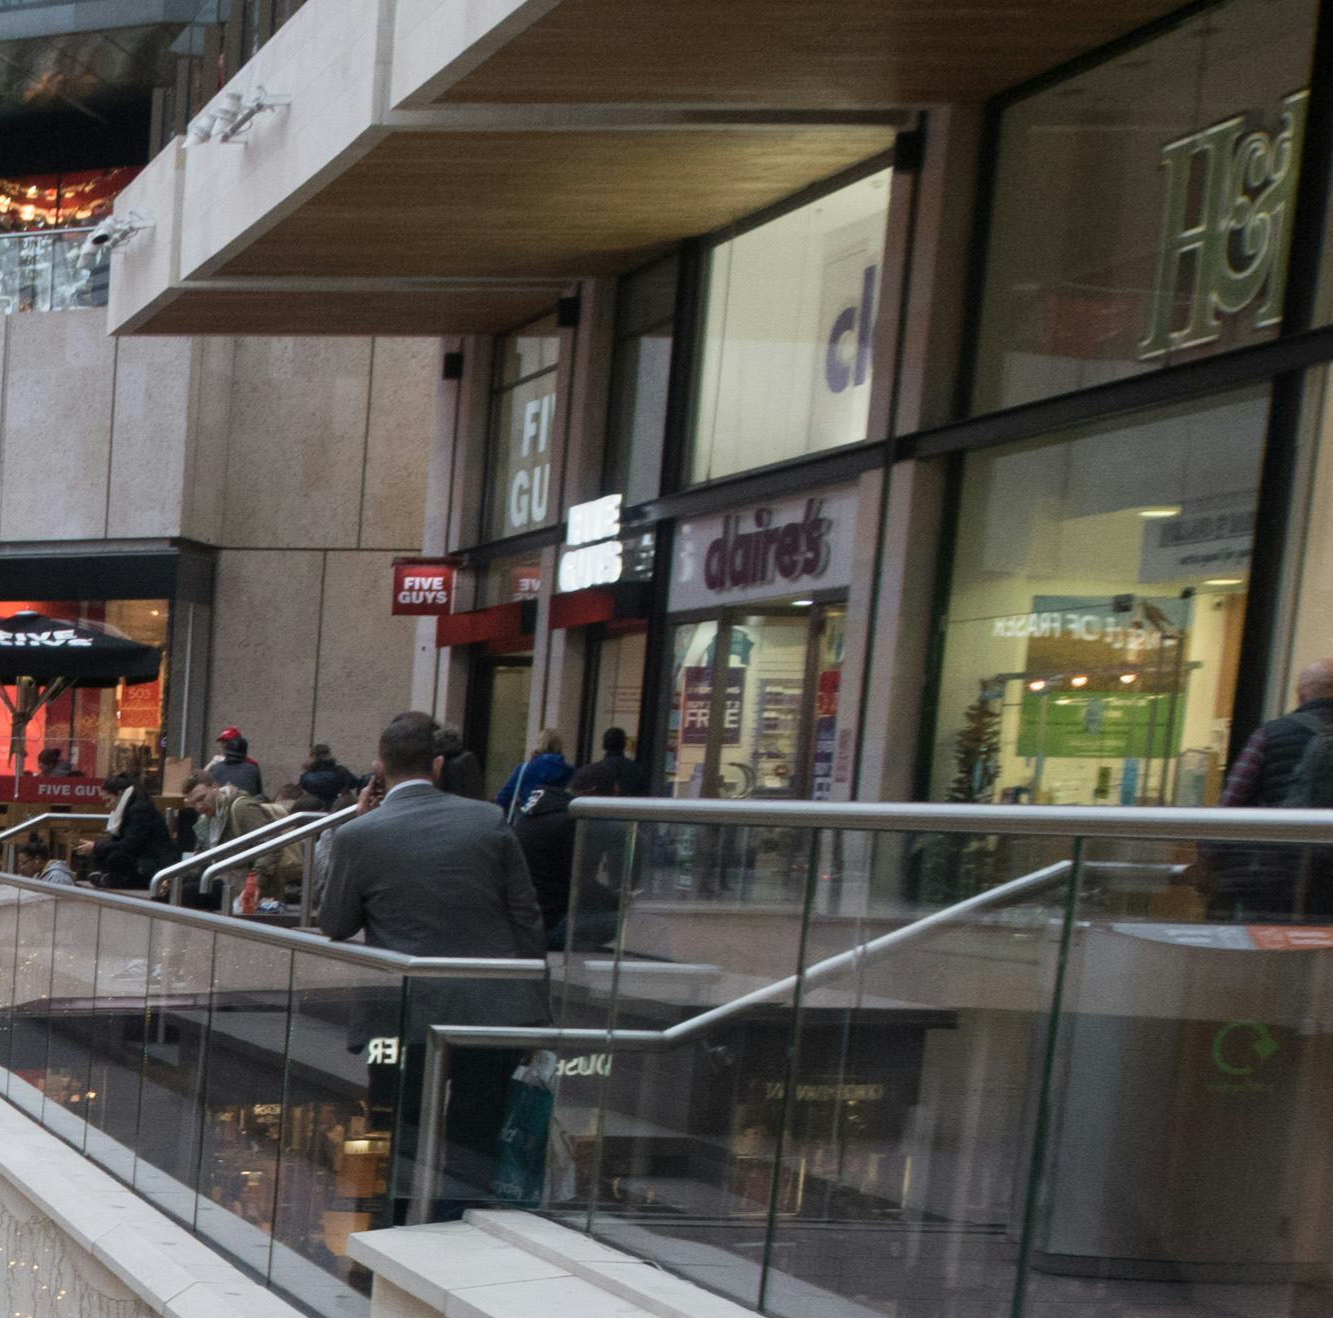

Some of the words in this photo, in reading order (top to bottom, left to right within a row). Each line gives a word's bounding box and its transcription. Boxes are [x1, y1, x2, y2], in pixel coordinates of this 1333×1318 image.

[403, 576, 444, 591] FIVE
[398, 590, 448, 605] GUYS
[684, 708, 740, 729] FRE
[38, 784, 70, 796] FIVE
[75, 785, 105, 797] GUY
